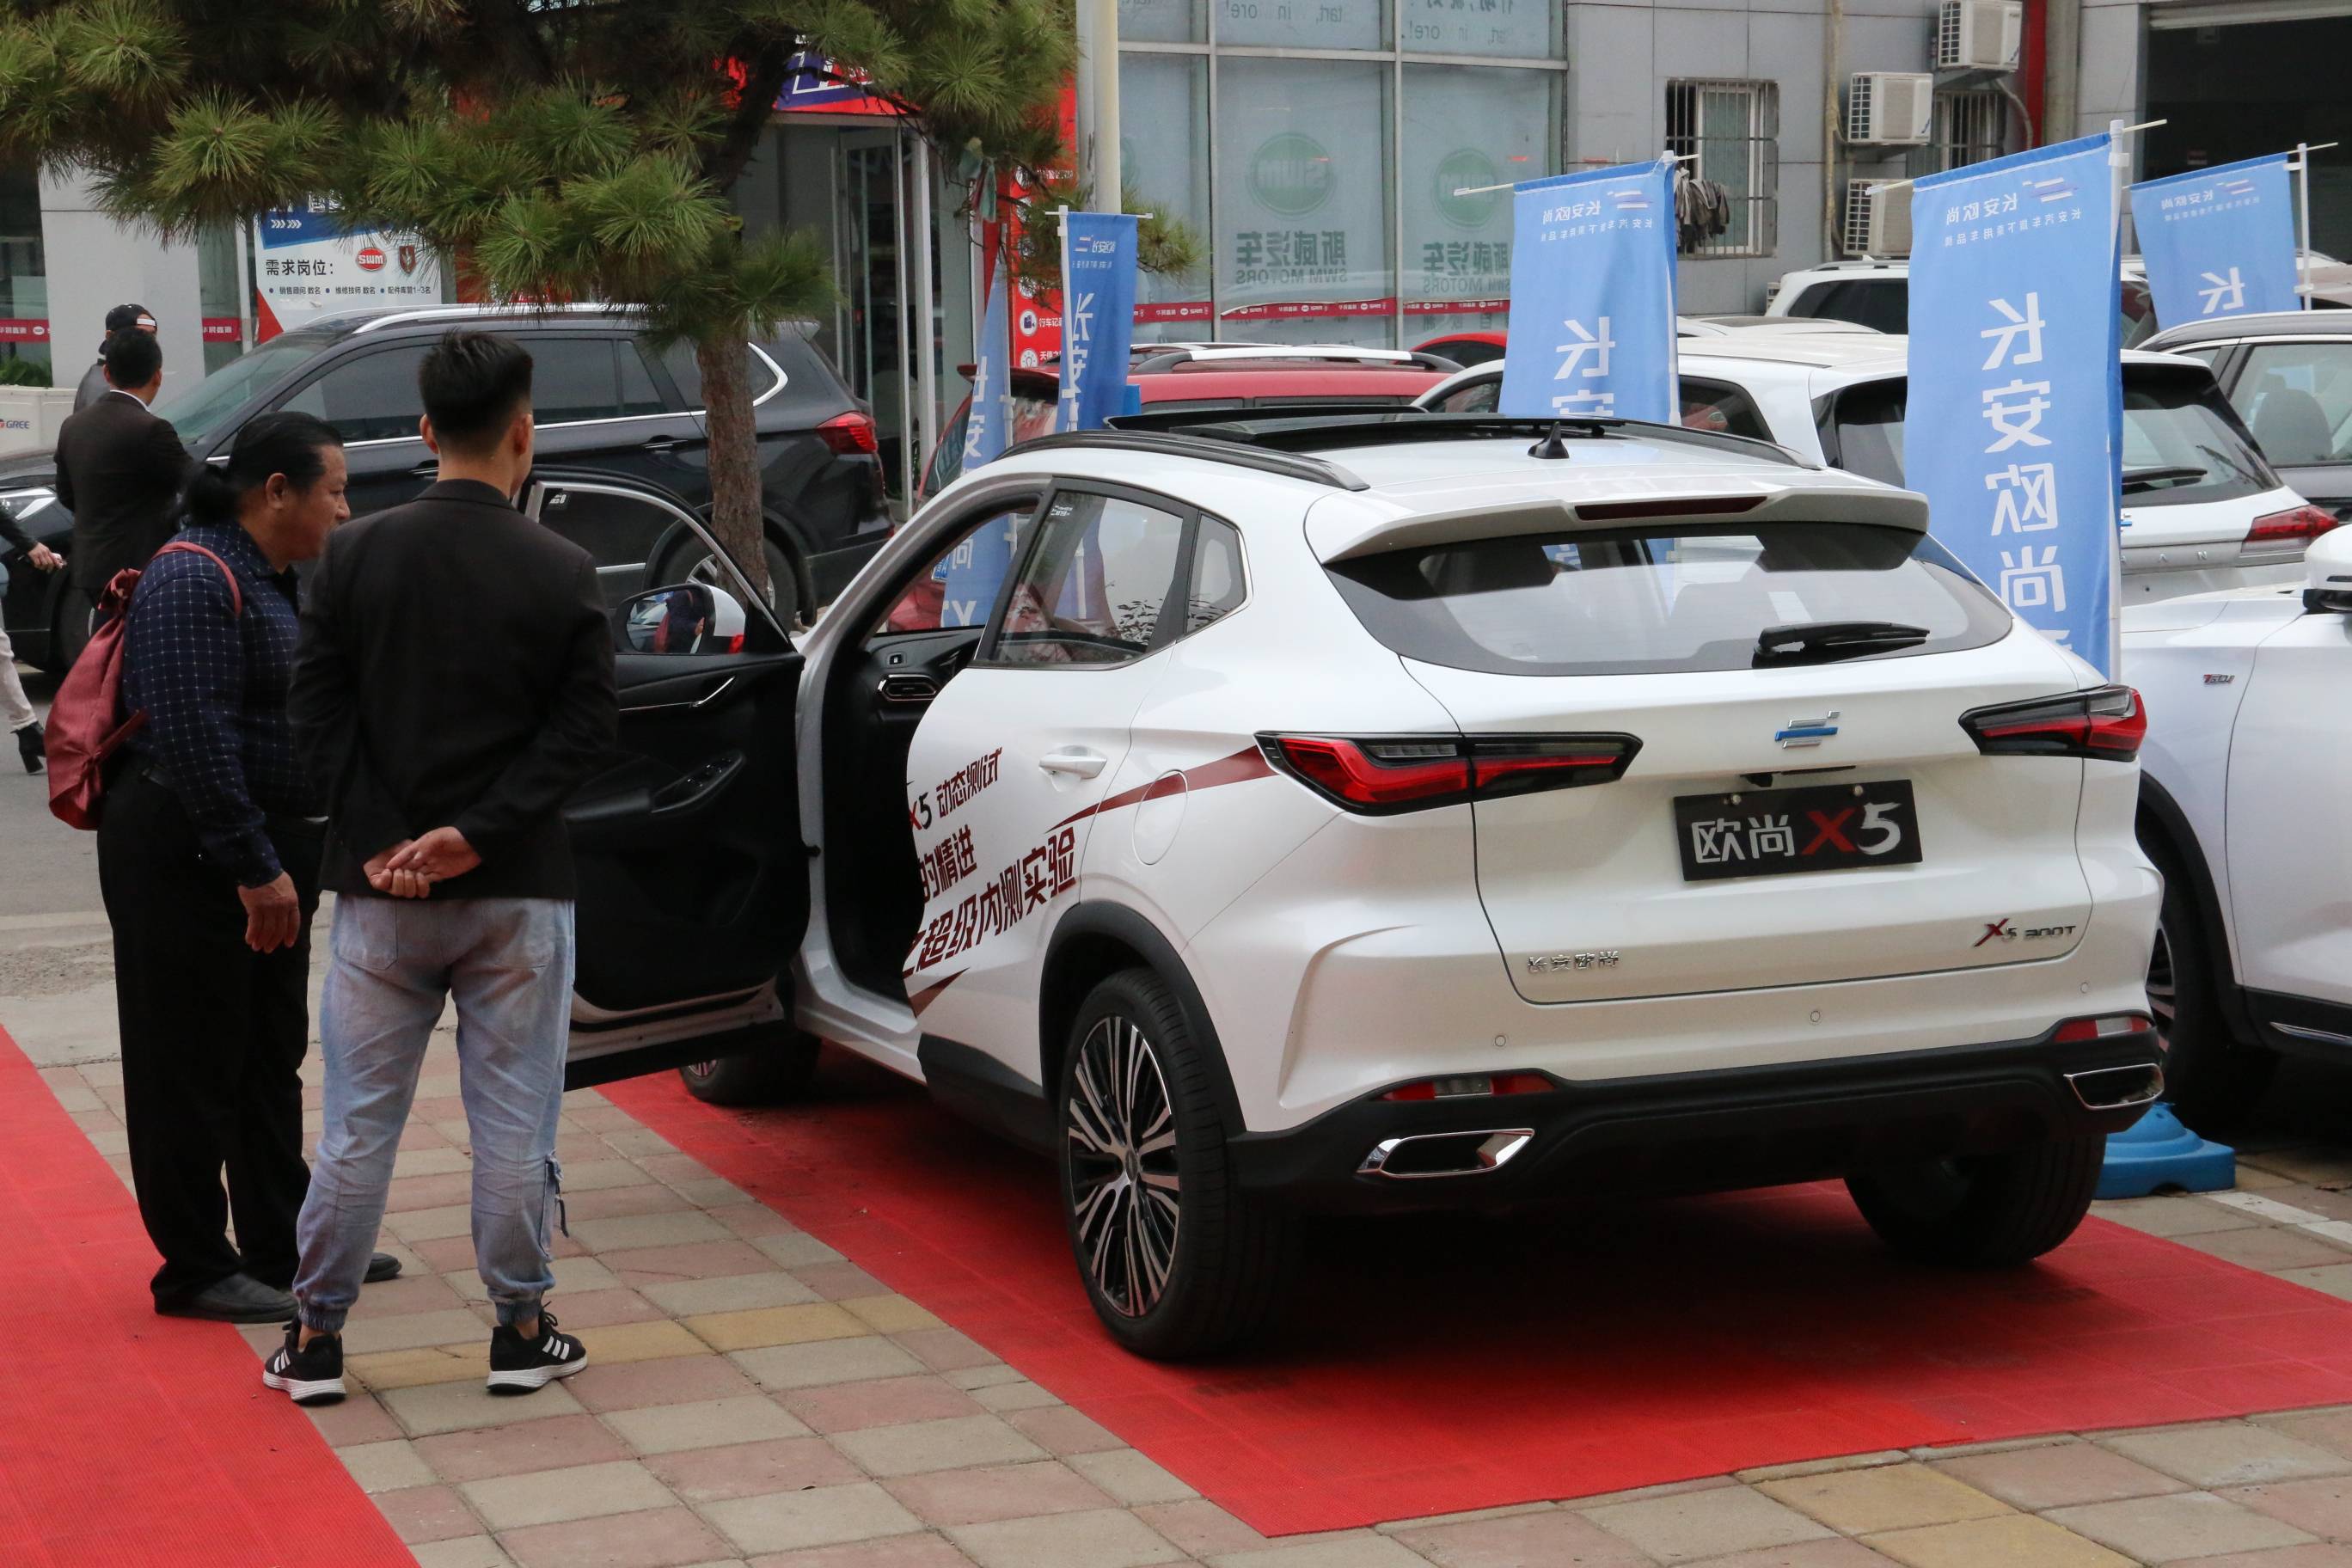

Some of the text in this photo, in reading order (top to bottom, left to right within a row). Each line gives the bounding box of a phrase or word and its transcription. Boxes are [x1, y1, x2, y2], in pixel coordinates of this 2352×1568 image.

[358, 254, 384, 266] SWM
[266, 259, 334, 277] 需求岗位：
[6, 420, 30, 429] GREE
[935, 746, 1003, 818] 动态测试
